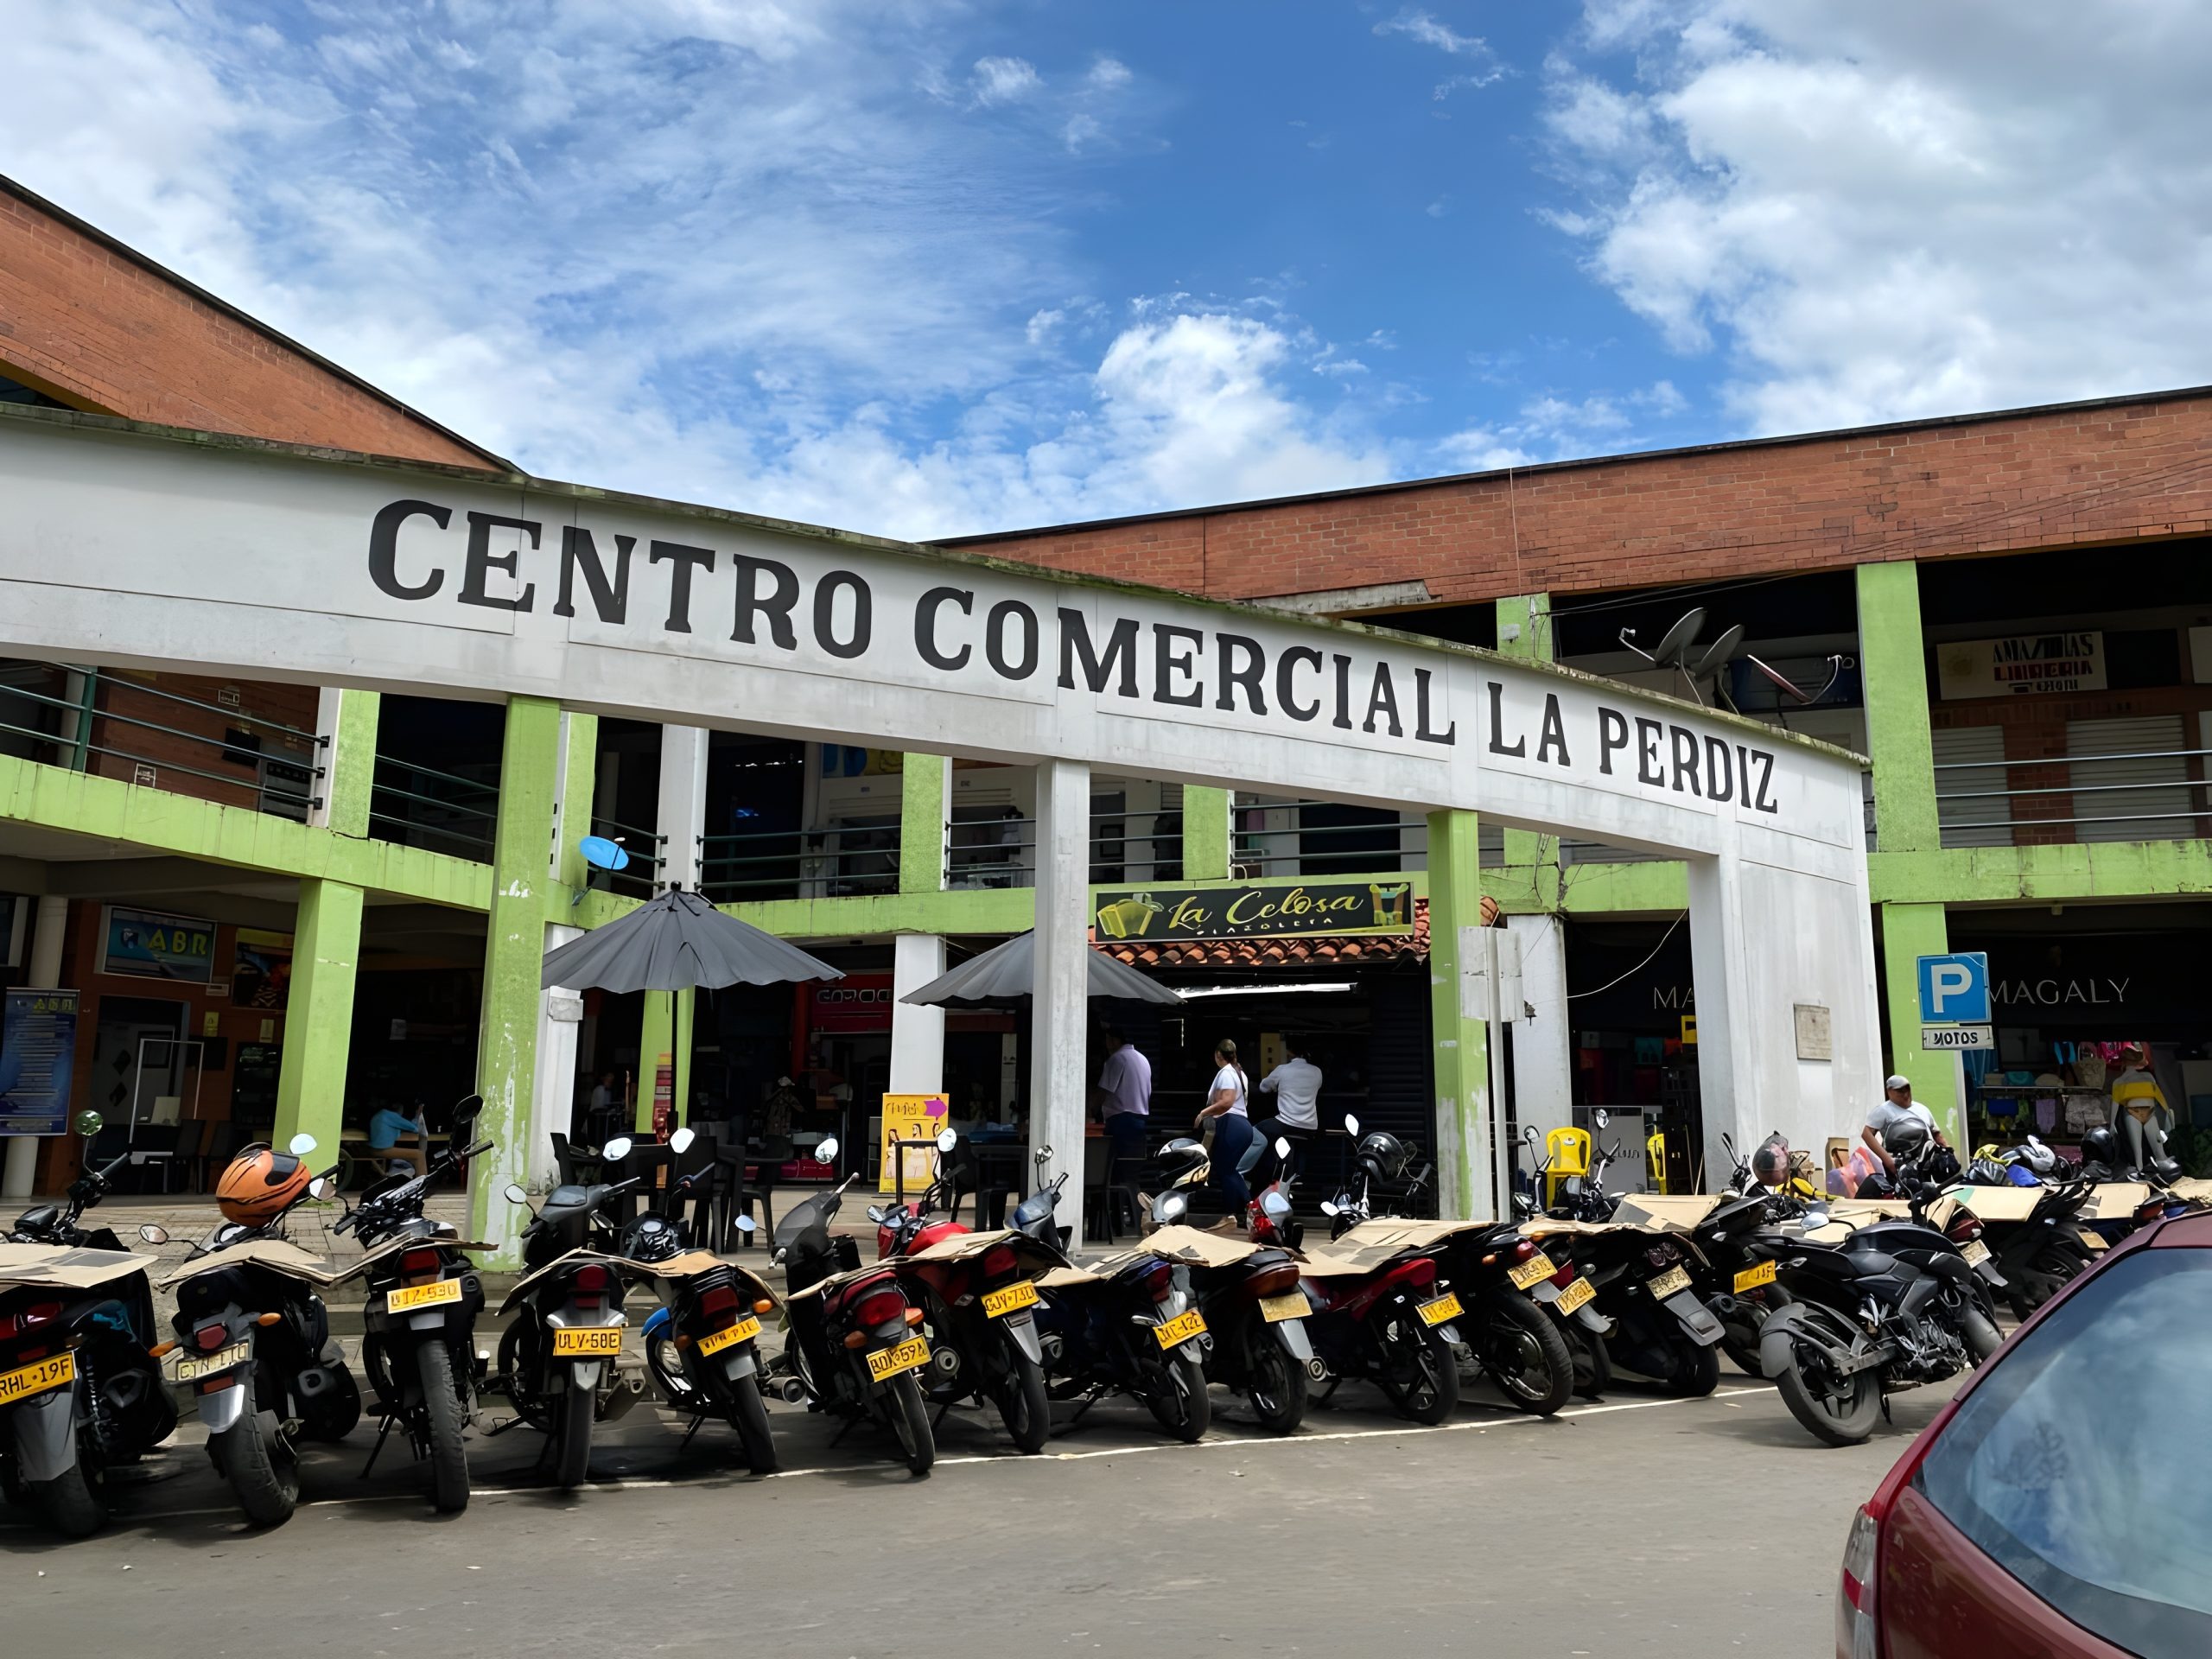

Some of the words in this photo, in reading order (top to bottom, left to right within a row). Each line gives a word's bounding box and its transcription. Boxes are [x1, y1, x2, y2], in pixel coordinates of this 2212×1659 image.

[368, 499, 872, 659] CENTRO
[914, 586, 1455, 746] COMERCIAL
[1487, 681, 1571, 767] LA
[1599, 707, 1778, 815] PERDIZ
[1168, 896, 1212, 930] La
[1226, 887, 1364, 925] Celosa
[1930, 963, 1973, 1014] P
[1988, 977, 2130, 1005] MAGALY
